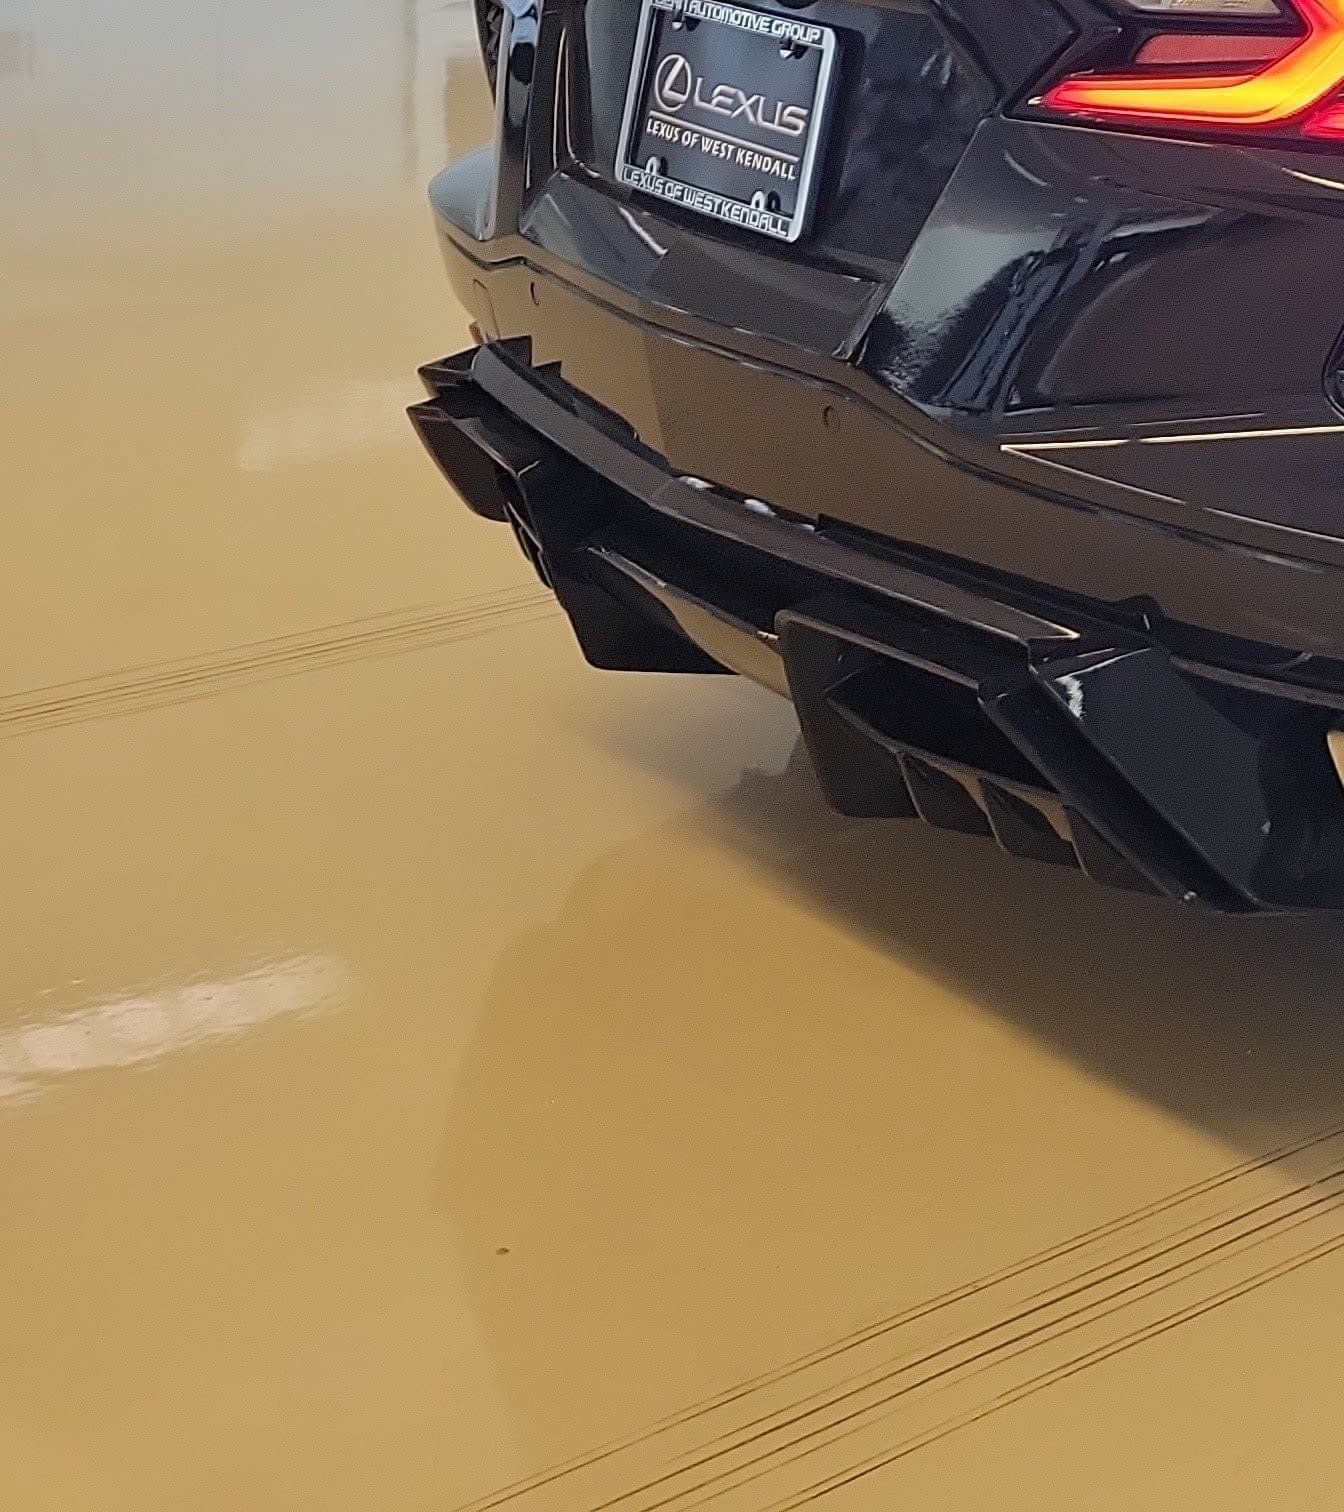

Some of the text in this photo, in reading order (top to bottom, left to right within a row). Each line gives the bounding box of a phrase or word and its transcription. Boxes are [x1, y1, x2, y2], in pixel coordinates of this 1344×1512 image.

[689, 0, 770, 31] AUTOMOTIVE
[771, 20, 822, 42] GROUP
[693, 77, 809, 137] LEXUS
[646, 118, 796, 181] LEXUS OF WEST KENDALL
[623, 167, 788, 236] LEXUS OF WEST KENDALL
